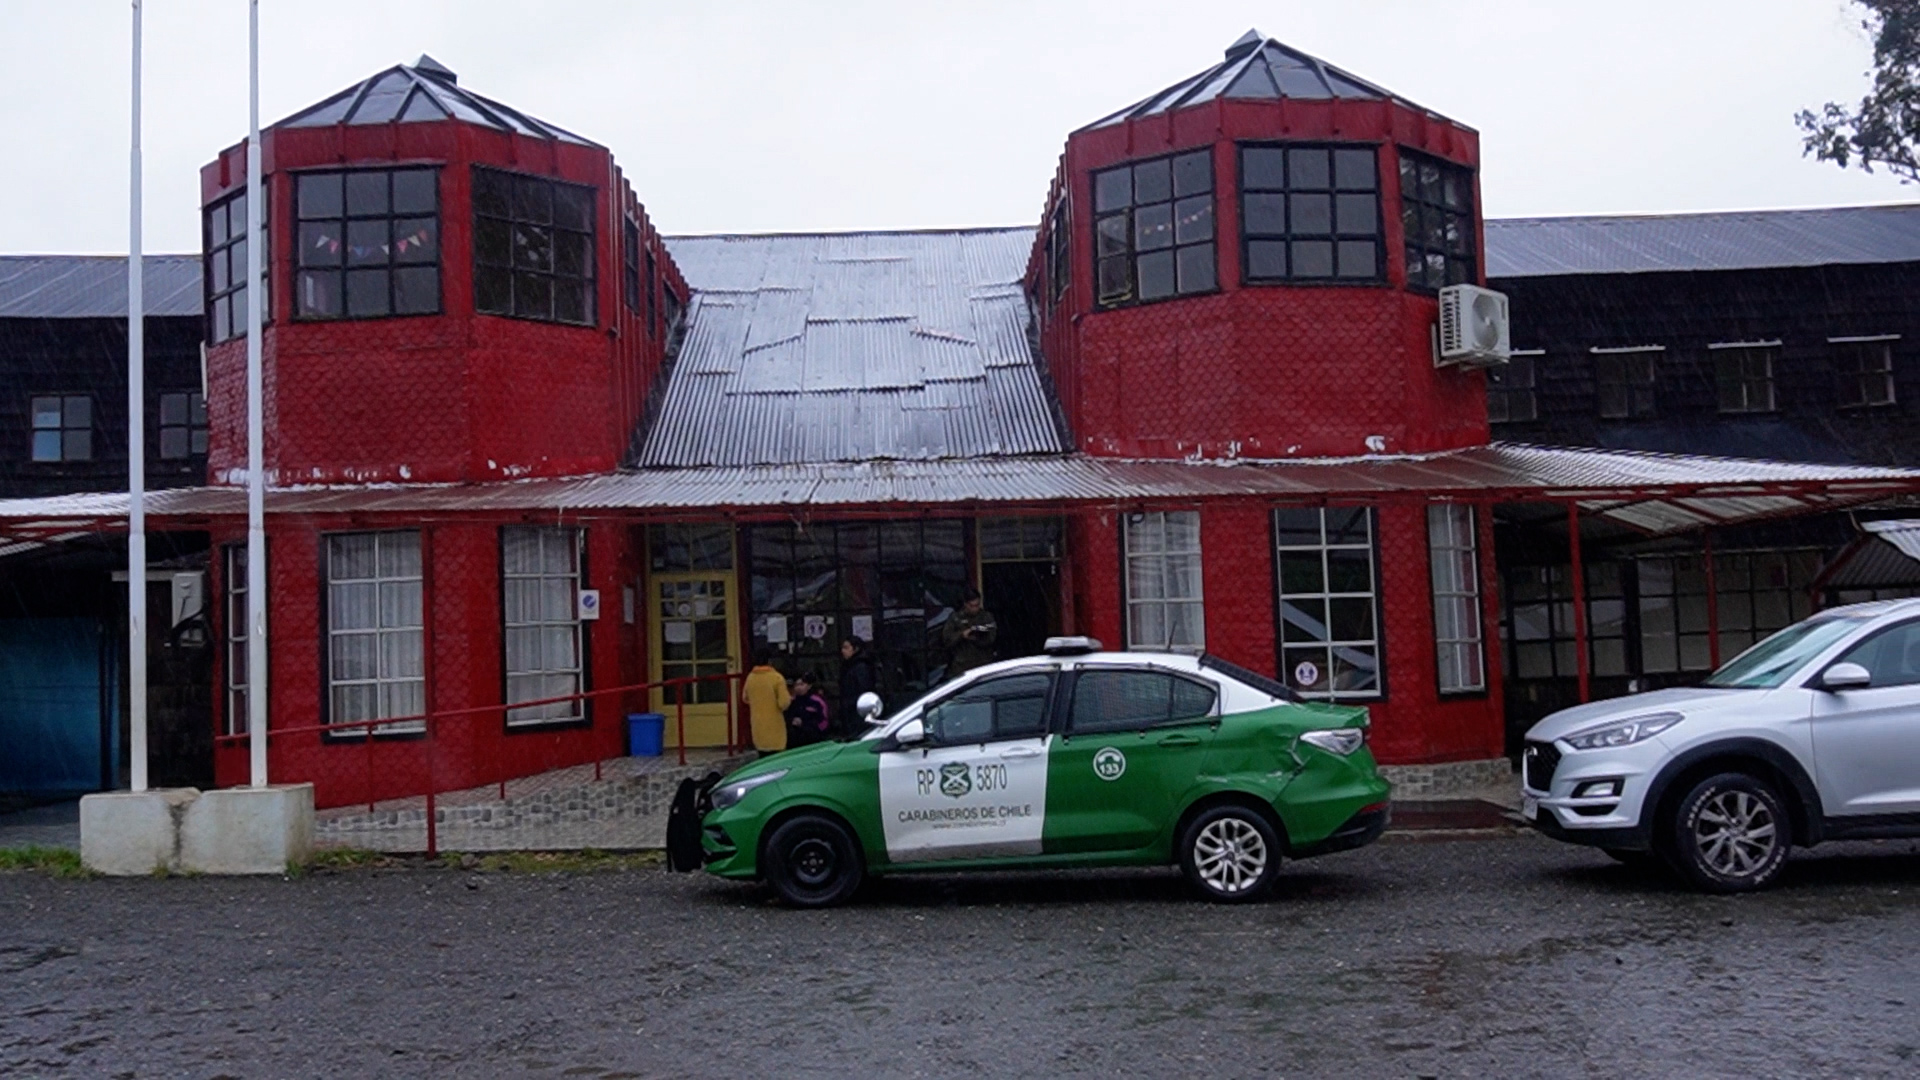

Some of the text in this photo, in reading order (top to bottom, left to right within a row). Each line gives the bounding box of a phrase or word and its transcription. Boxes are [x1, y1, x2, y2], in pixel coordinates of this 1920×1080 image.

[917, 763, 1008, 795] RP 5870
[898, 804, 1032, 823] CARABINEROS DE CHILE
